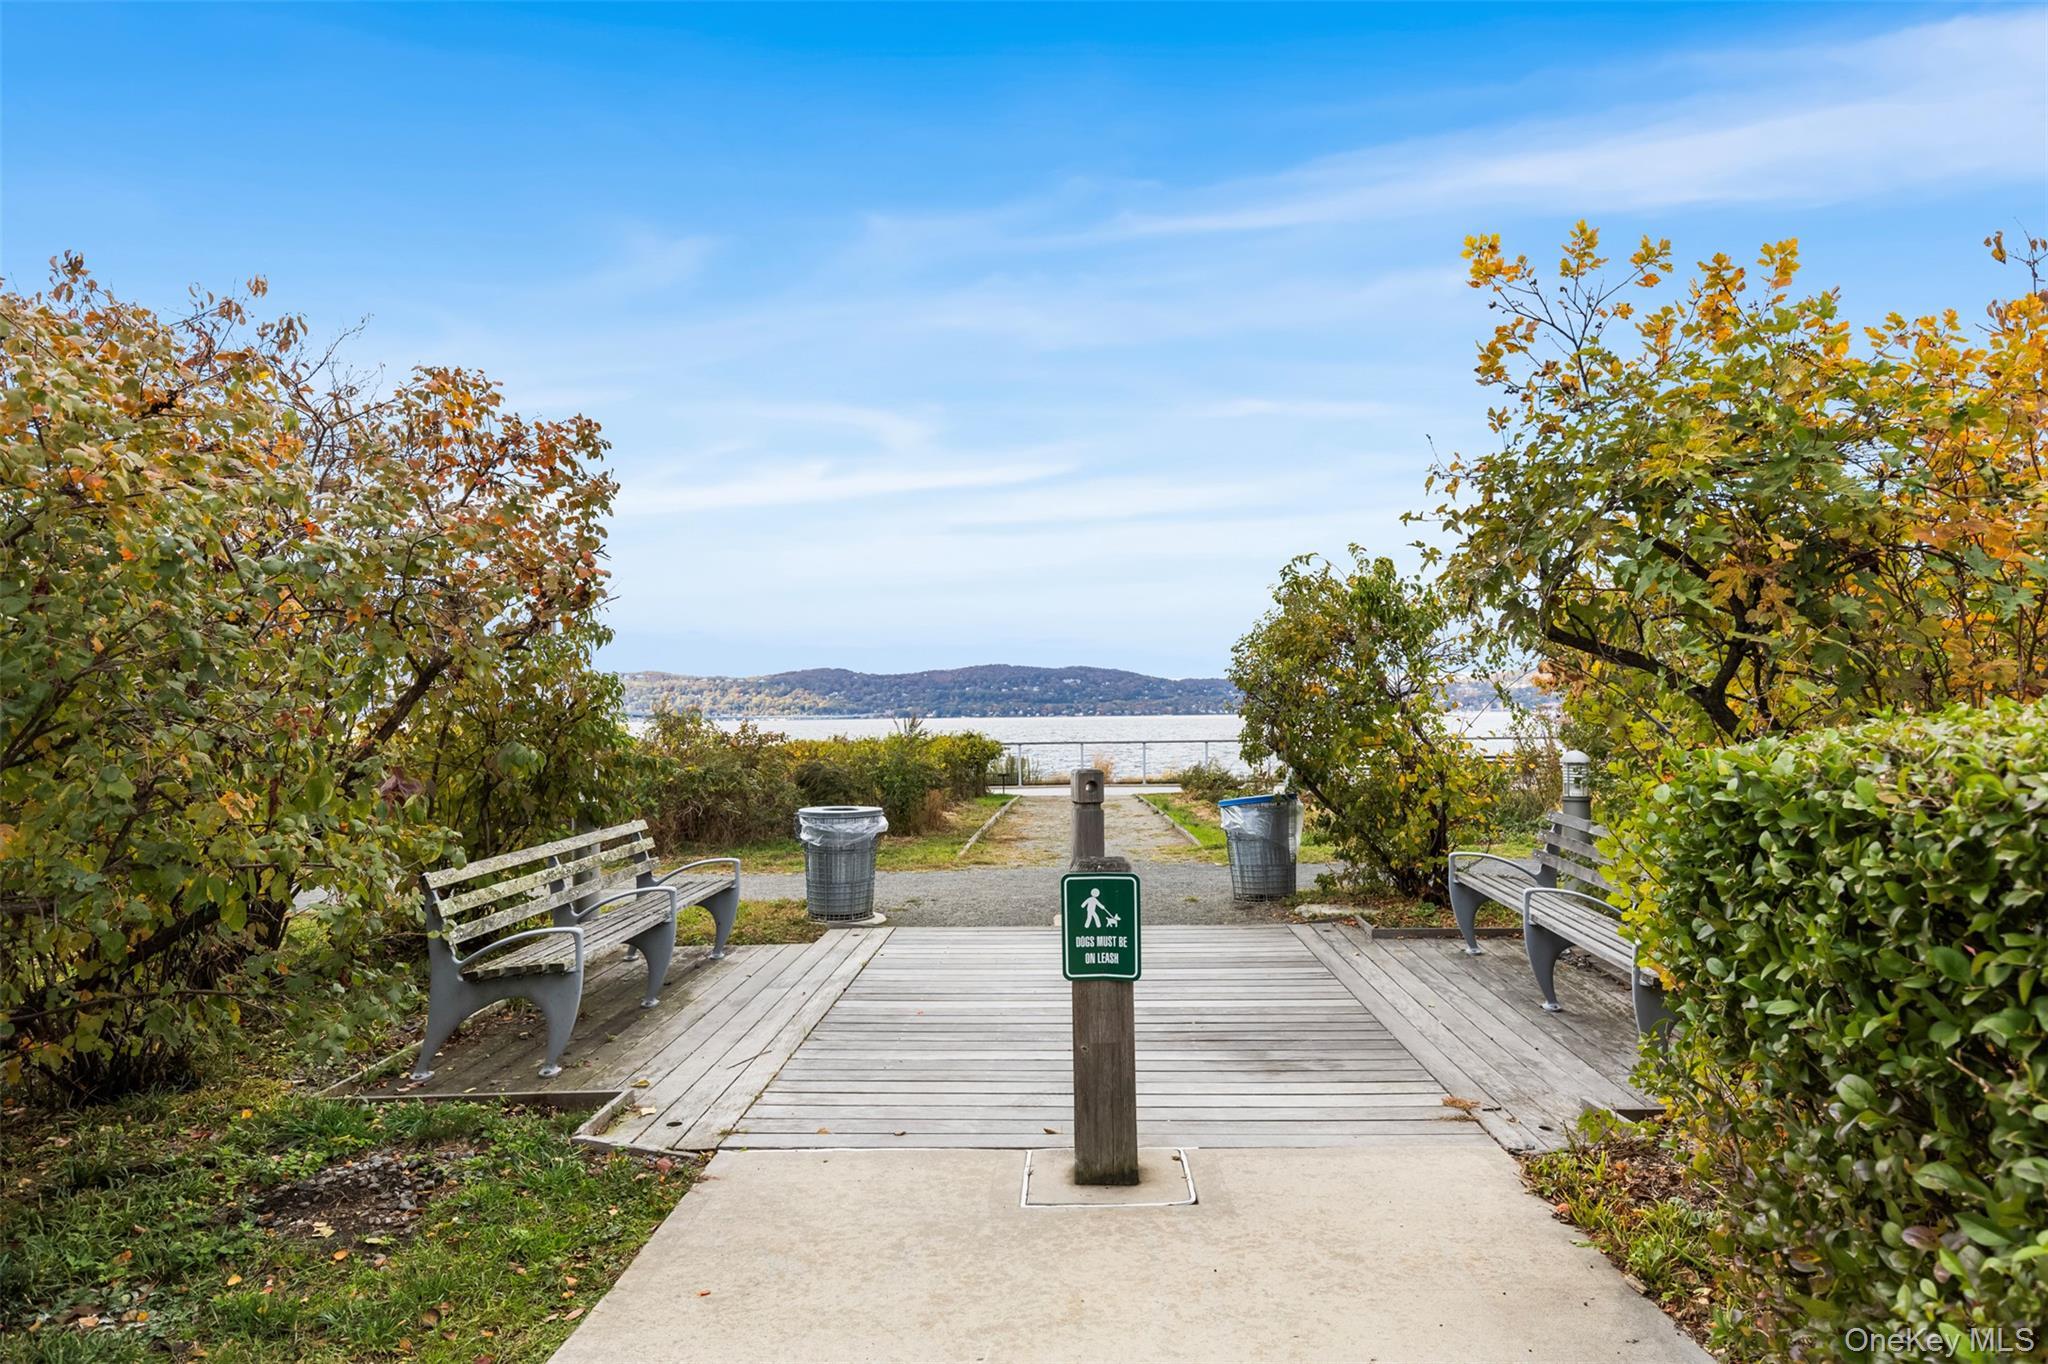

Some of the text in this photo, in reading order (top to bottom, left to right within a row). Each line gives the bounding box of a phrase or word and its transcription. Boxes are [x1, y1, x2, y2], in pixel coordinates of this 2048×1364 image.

[1075, 936, 1128, 948] DOGS MUST BE
[1085, 952, 1119, 964] ON LEASH
